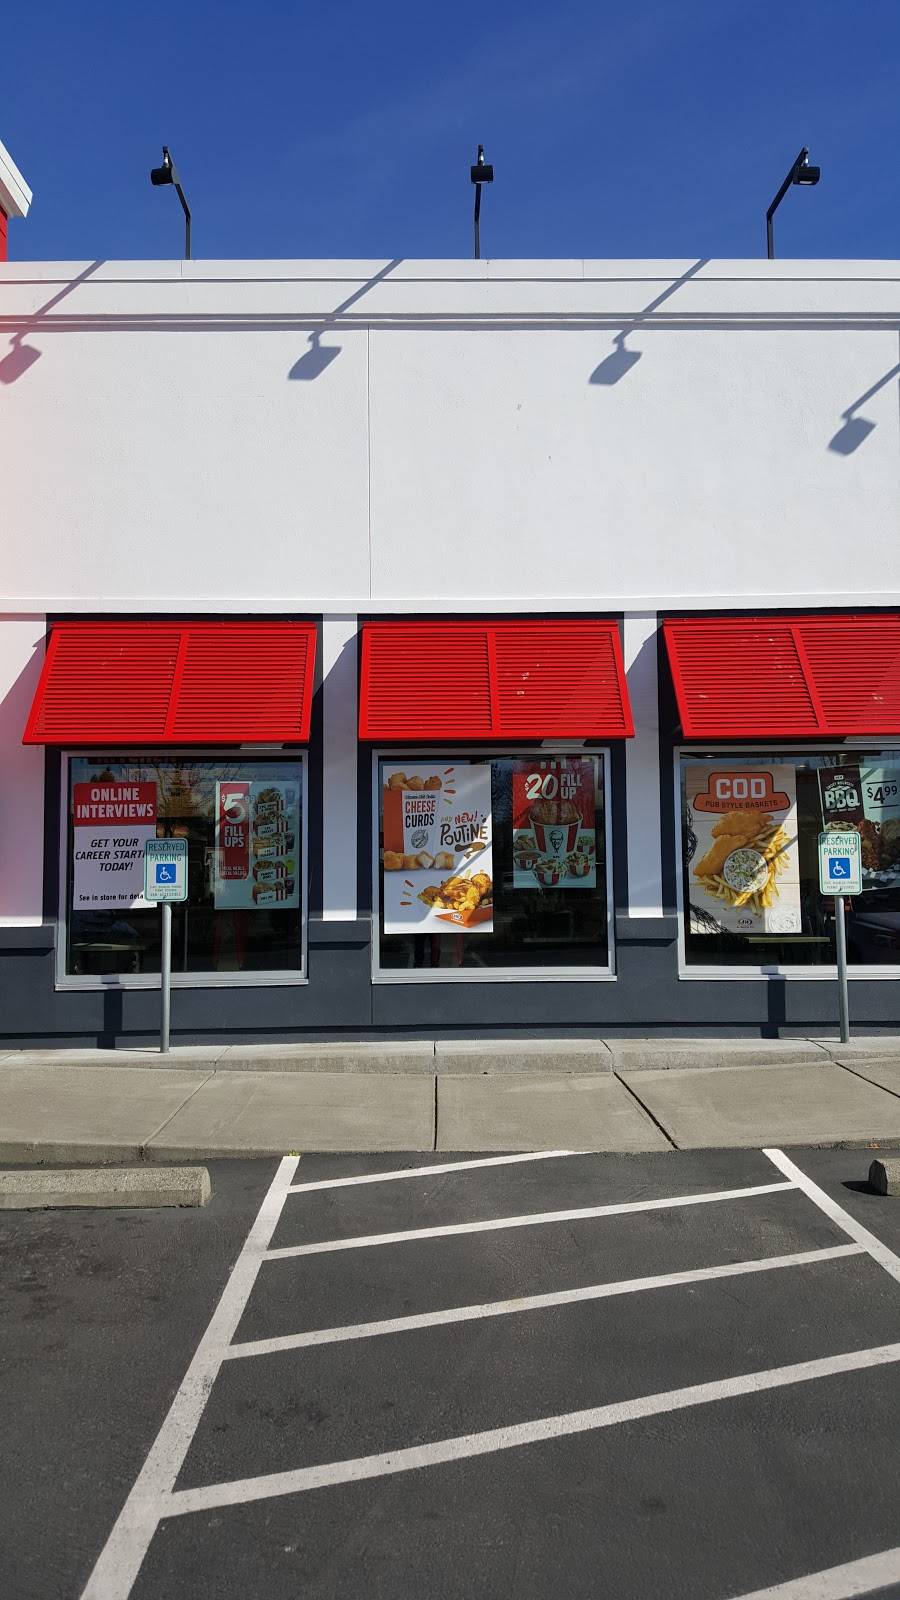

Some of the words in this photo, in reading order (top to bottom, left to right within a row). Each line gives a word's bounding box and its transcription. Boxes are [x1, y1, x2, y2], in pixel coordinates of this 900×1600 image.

[525, 773, 559, 800] $20
[560, 773, 582, 787] FILL
[716, 778, 766, 799] COD
[91, 787, 140, 802] ONLINE
[560, 786, 577, 800] UP
[705, 800, 720, 808] PUB
[721, 801, 744, 809] STYLE
[745, 800, 778, 809] BASKETS
[824, 789, 860, 810] BBQ
[76, 803, 154, 818] INTERVIEWS
[405, 800, 436, 814] CHEESE
[405, 813, 435, 828] CURDS
[454, 810, 478, 825] NEW!
[224, 825, 243, 837] FILL
[90, 838, 110, 848] GET
[112, 838, 139, 848] YOUR
[148, 842, 185, 851] RESERVED
[224, 837, 245, 848] UPS
[821, 837, 857, 845] RESERVED
[75, 850, 111, 861] CAREER
[823, 847, 855, 856] PARKING
[150, 853, 182, 862] PARKING
[99, 861, 134, 872] TODAY!
[92, 893, 98, 901] in
[118, 893, 127, 901] for
[129, 892, 144, 900] deta
